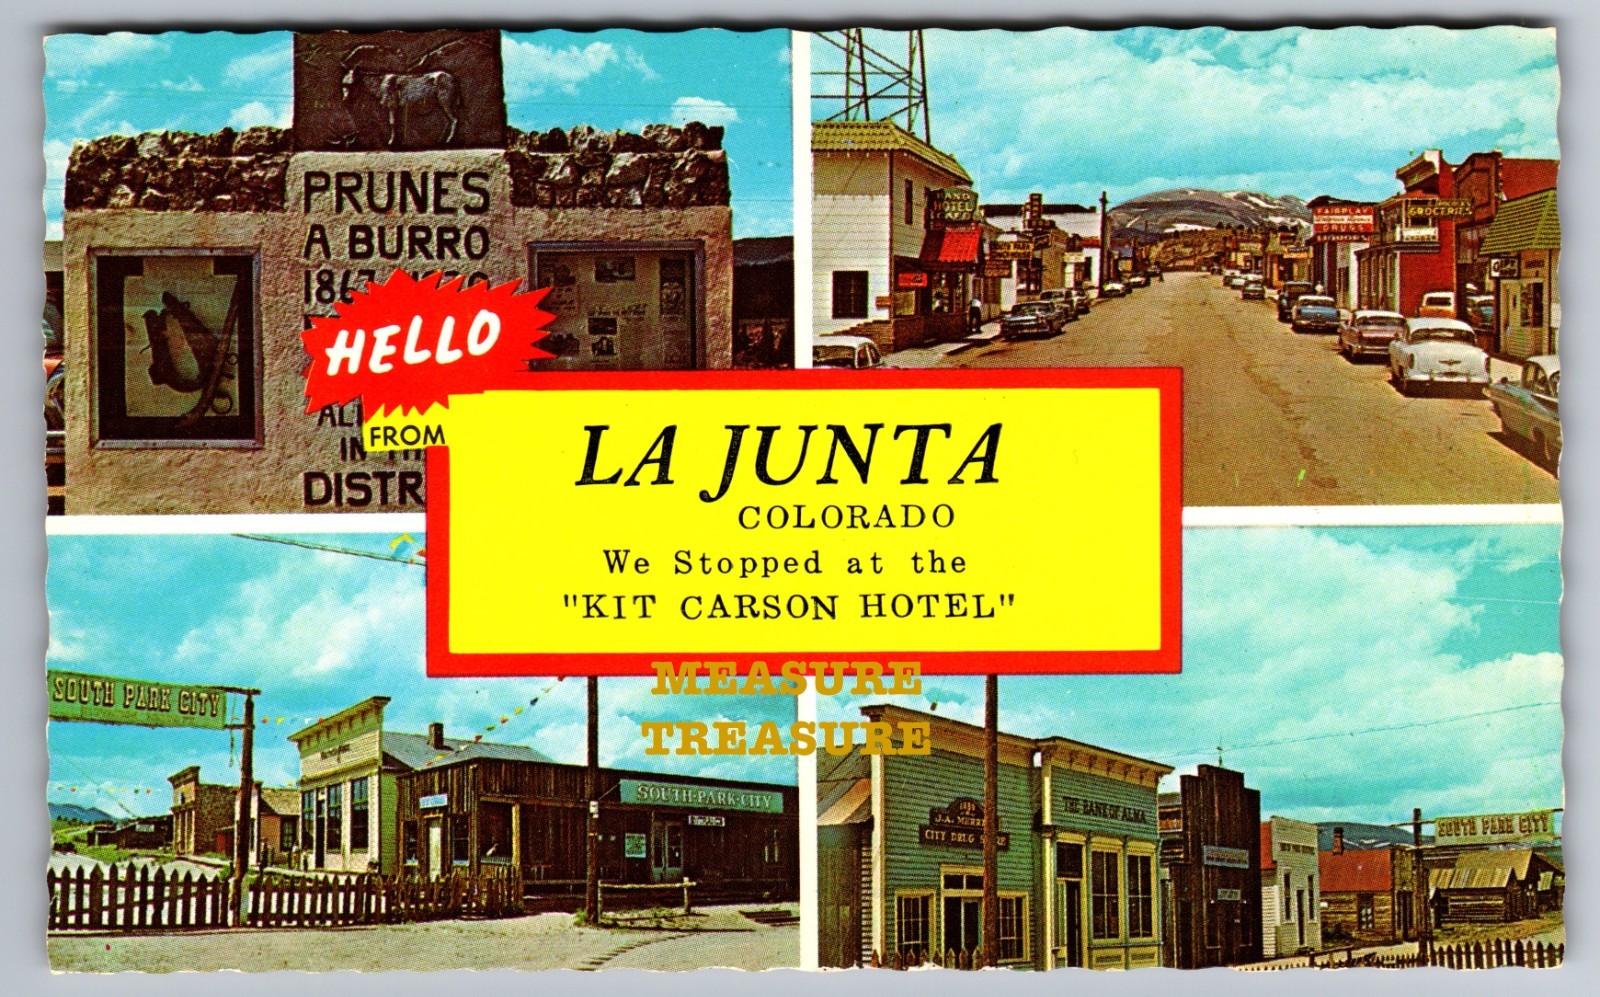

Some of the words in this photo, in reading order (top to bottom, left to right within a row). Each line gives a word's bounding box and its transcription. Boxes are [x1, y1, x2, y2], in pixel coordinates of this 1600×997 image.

[303, 170, 490, 215] PRUNES
[933, 201, 973, 212] HOTEL
[1316, 207, 1368, 215] FAIRPLAY
[1322, 223, 1365, 232] DRUGS
[304, 223, 331, 259] A
[349, 224, 489, 260] BURRO
[325, 308, 501, 376] HELLO
[370, 424, 446, 447] FROM
[575, 425, 677, 486] LA
[699, 423, 1003, 502] JUNTA
[303, 471, 426, 507] DISTR
[739, 504, 955, 529] COLORADO
[603, 549, 650, 574] We
[674, 549, 822, 578] Stopped
[847, 552, 883, 574] at
[911, 549, 966, 574] the
[563, 594, 656, 619] "KIT
[680, 593, 838, 620] CARSON
[860, 592, 1015, 619] HOTEL"
[53, 676, 114, 706] SOUTH
[123, 684, 171, 711] PARK
[178, 690, 220, 716] CITY
[637, 783, 692, 802] SOUTH
[698, 790, 736, 806] PARK
[741, 793, 772, 808] CITY
[924, 829, 946, 841] CITY
[950, 832, 975, 843] DRUG
[1437, 818, 1477, 836] SOUTH
[1481, 817, 1514, 834] PARK
[1518, 813, 1548, 833] CITY
